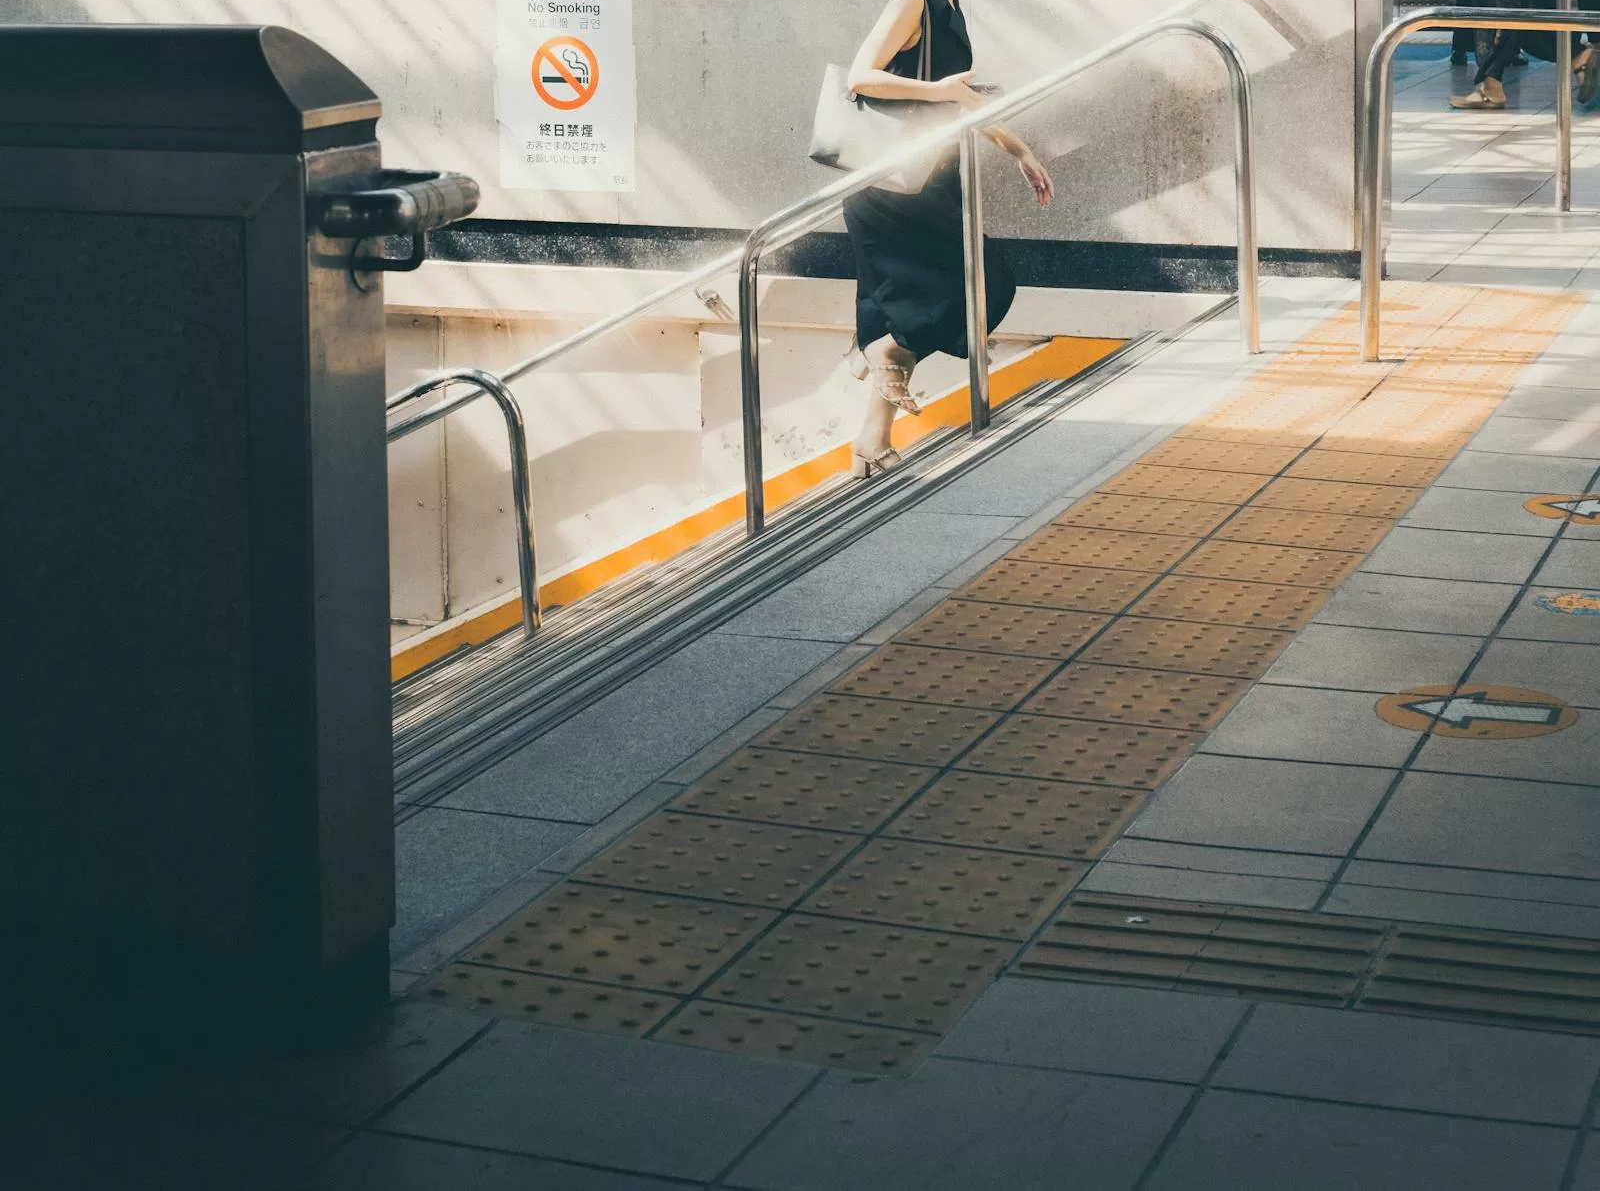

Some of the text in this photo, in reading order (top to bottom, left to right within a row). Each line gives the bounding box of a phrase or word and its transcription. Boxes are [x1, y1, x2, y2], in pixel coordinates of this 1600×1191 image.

[528, 1, 601, 16] No Smoking
[539, 123, 594, 138] 終日禁煙
